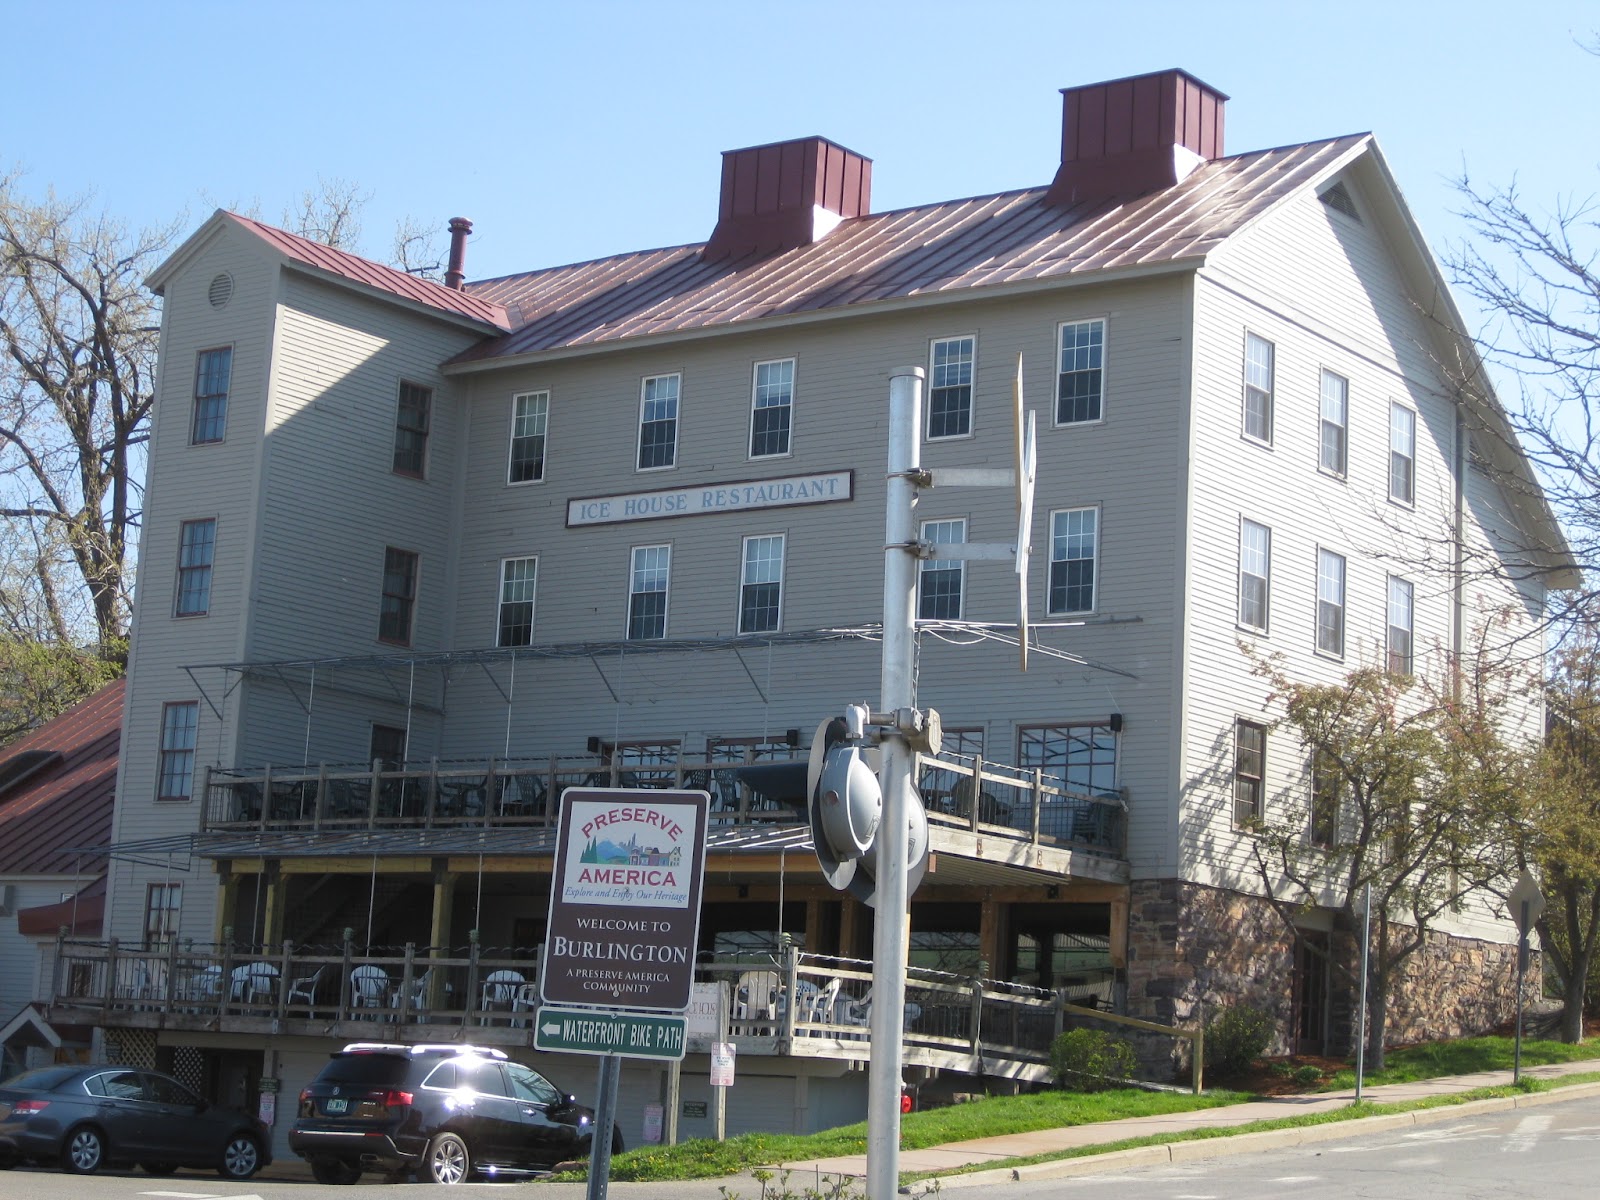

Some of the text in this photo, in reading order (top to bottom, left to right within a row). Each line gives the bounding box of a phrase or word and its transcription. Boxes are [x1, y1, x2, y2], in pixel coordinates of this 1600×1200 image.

[580, 477, 839, 520] ICE HOUSE RESTAURANT
[581, 807, 684, 842] PRESERVE
[578, 868, 677, 887] AMERICA
[565, 886, 688, 903] Explore and Enjoy Our Heritage
[577, 918, 671, 932] WELCOME TO
[553, 936, 688, 964] BURLINGTON
[566, 968, 670, 982] A PRESERVE AMERICA
[583, 981, 651, 993] COMMUNITY
[562, 1019, 682, 1050] WATERFRONT BIKE PATH
